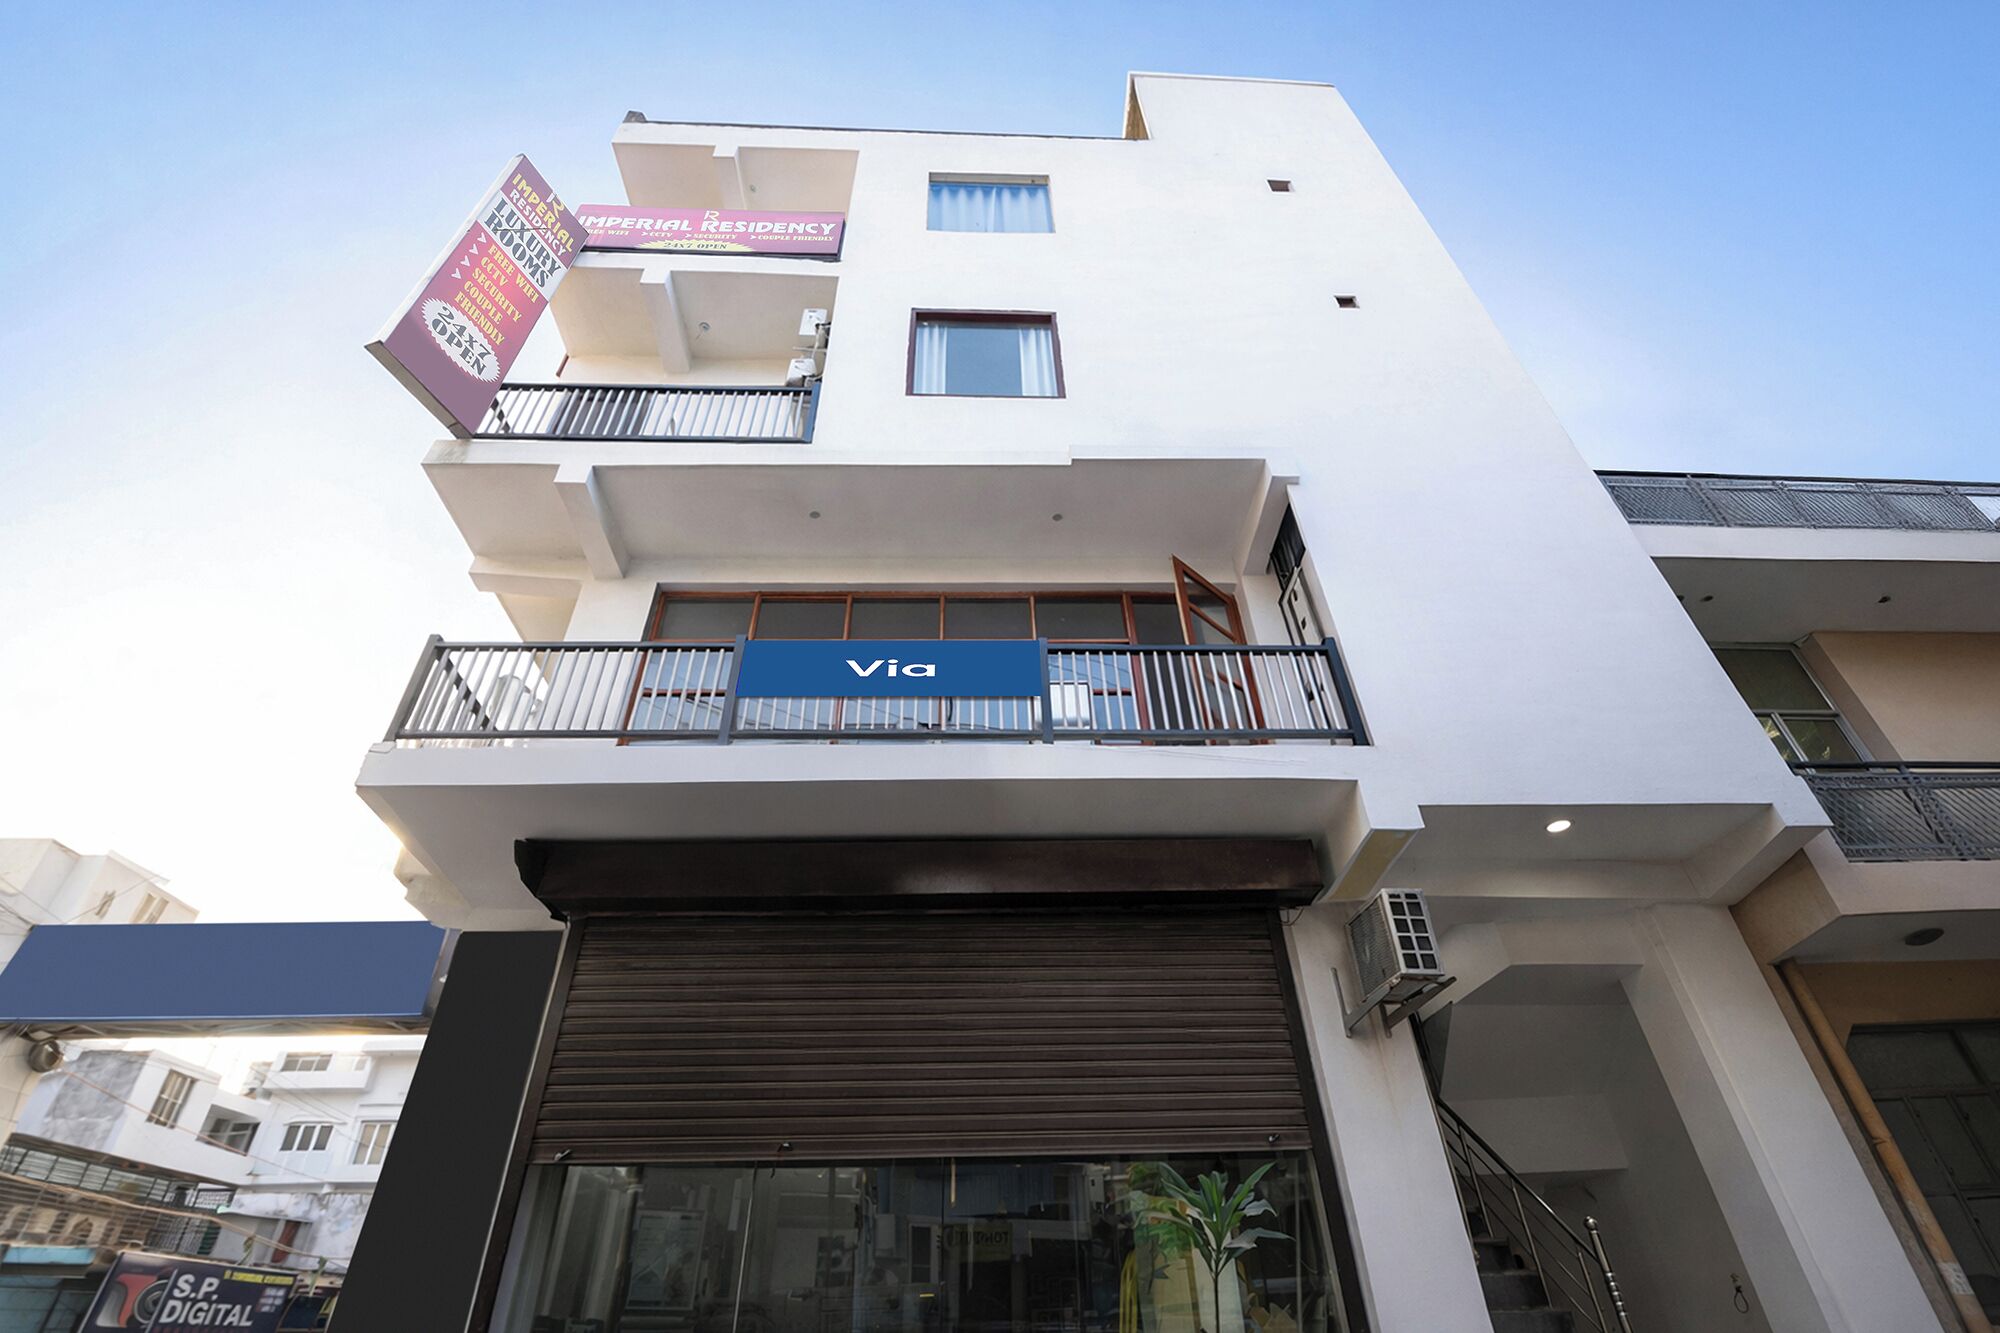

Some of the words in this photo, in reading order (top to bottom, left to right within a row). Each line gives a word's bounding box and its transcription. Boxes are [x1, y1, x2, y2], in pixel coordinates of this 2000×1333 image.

[494, 197, 561, 276] LUXURY
[510, 189, 566, 256] RESIDENCY
[513, 174, 574, 252] IMPERIAL
[579, 215, 692, 231] IMPERIAL
[701, 221, 836, 235] RESIDENCY
[481, 257, 509, 287] CCTV
[484, 210, 548, 288] ROOMS
[488, 244, 515, 276] FREE
[515, 273, 539, 303] WIFI
[454, 291, 505, 345] FRIENDLY
[464, 281, 503, 324] COUPLE
[472, 268, 522, 322] SECURITY
[432, 318, 486, 375] OPEN
[845, 659, 935, 677] Via
[173, 1273, 220, 1300] S.P.
